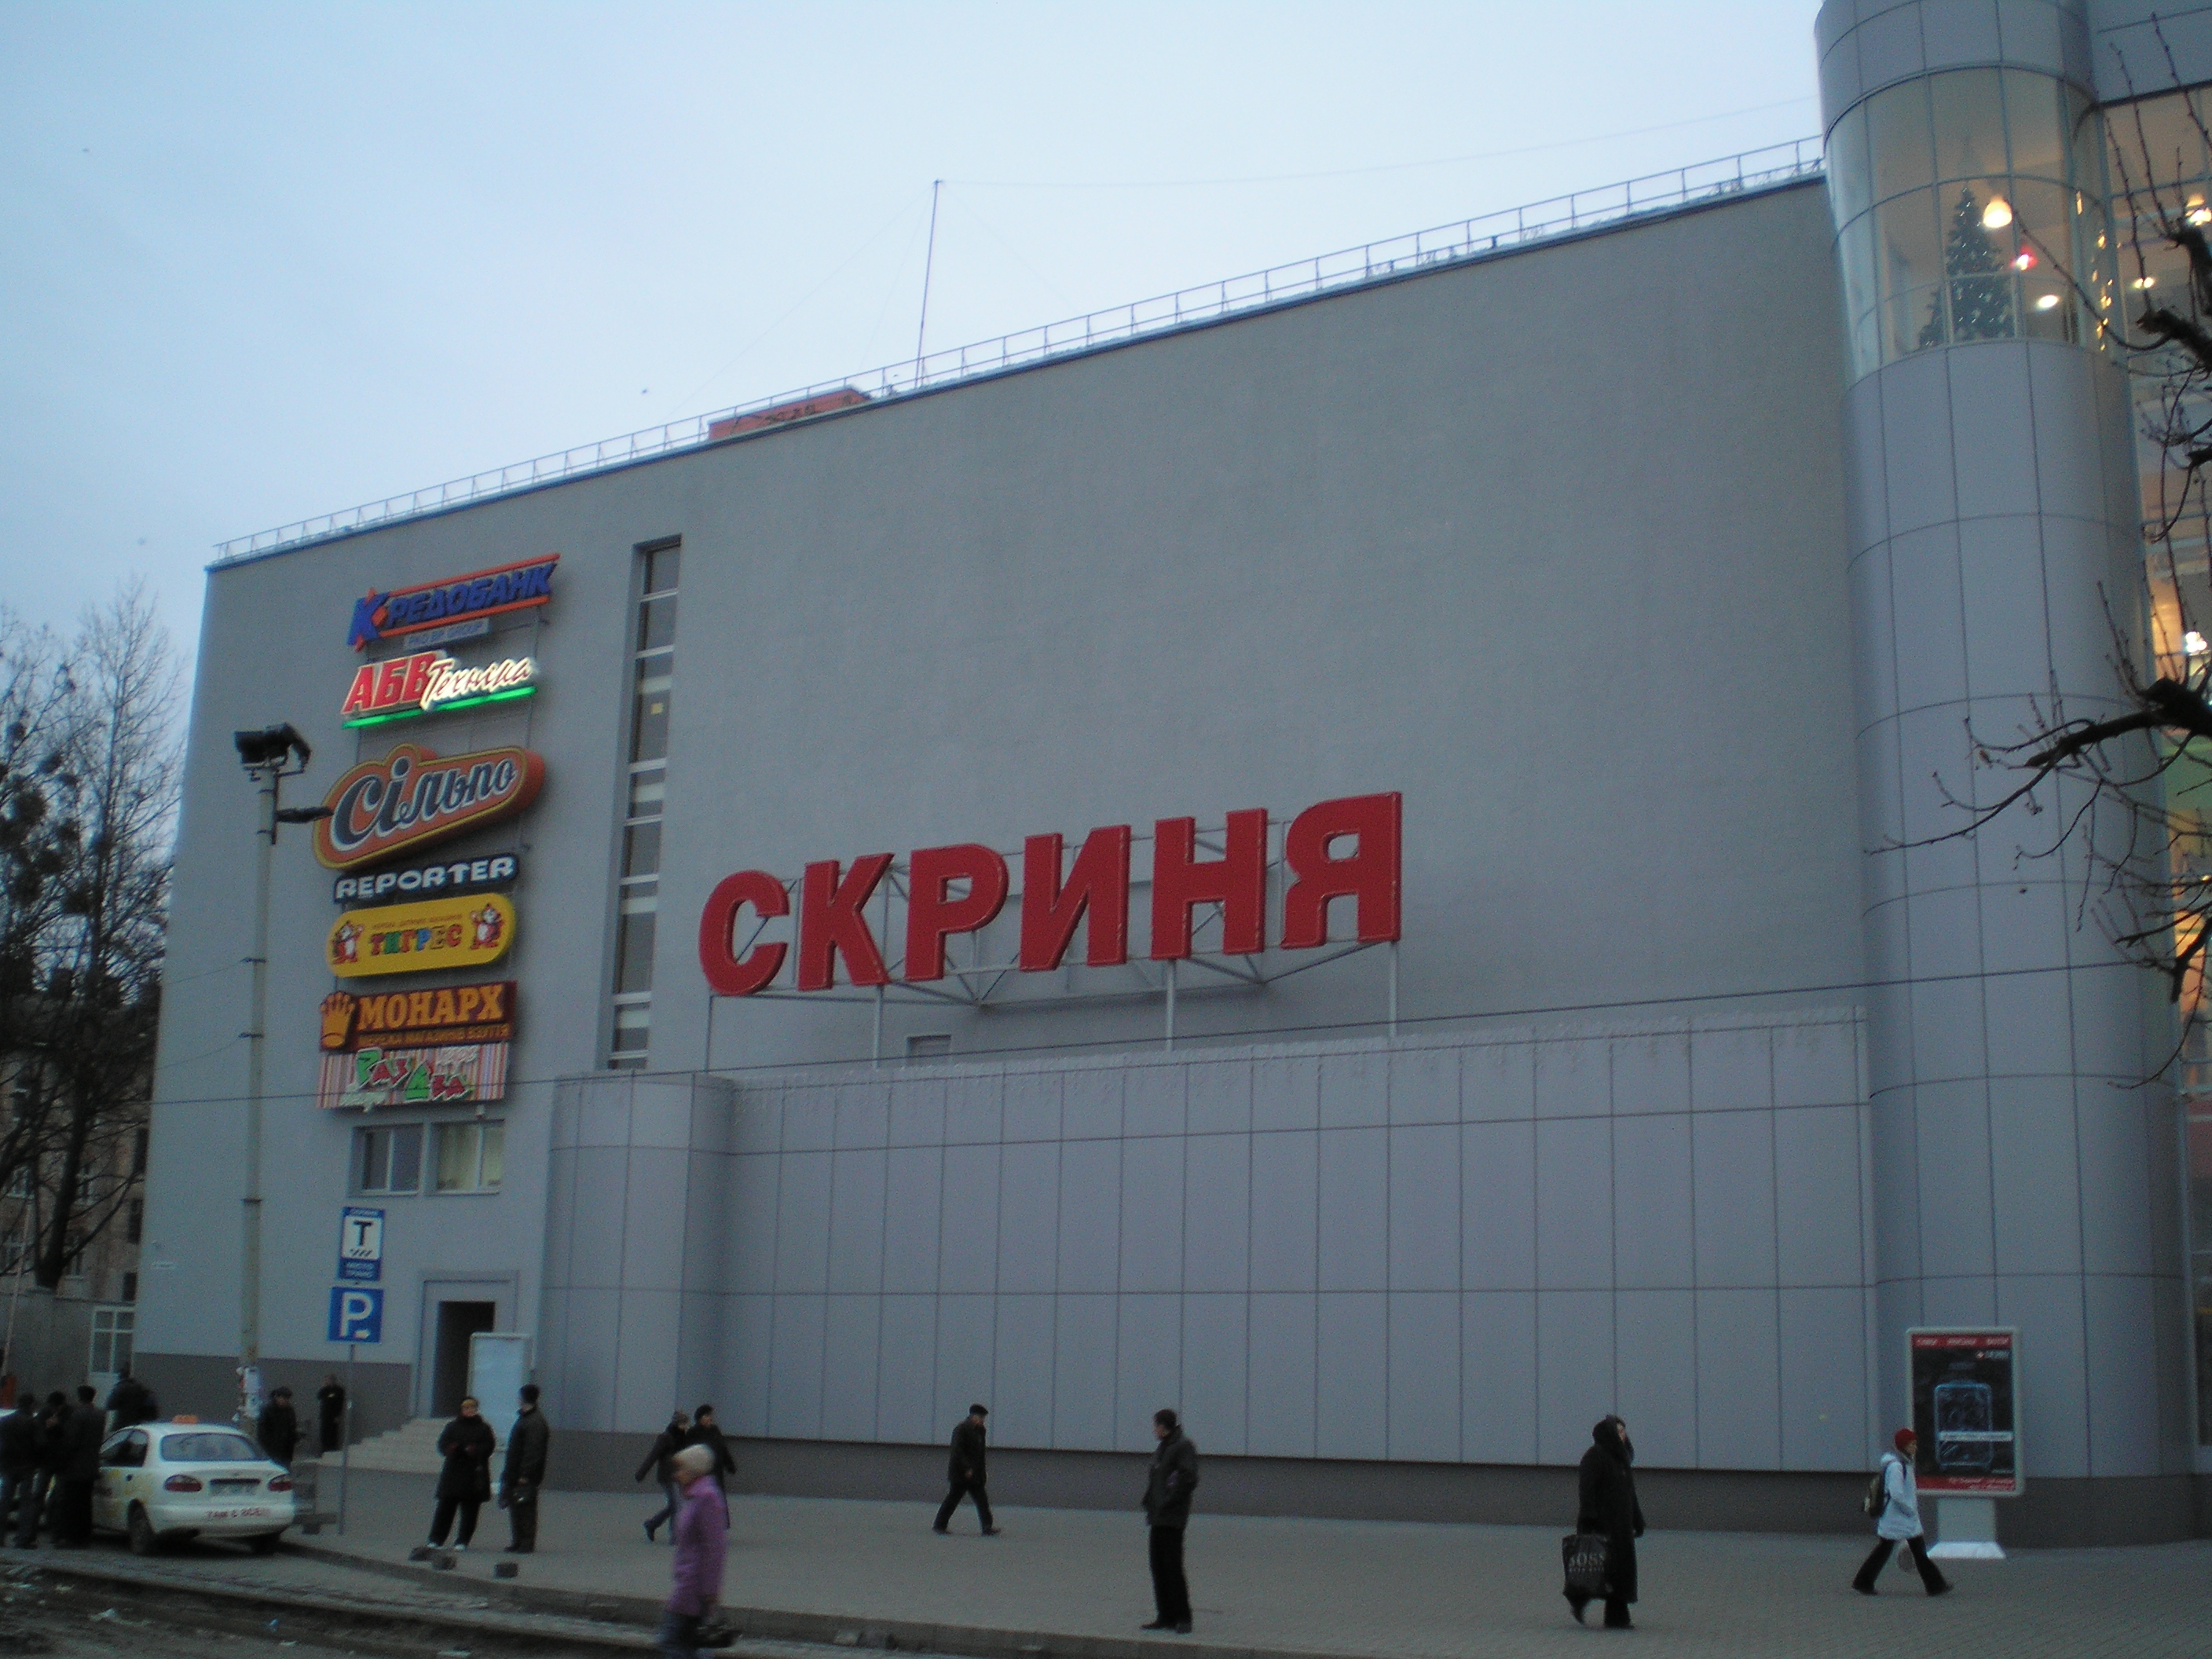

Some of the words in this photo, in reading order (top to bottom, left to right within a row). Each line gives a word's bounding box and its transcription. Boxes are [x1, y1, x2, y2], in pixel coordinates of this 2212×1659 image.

[342, 651, 441, 713] АБВ
[330, 756, 516, 851] Сільпо
[336, 856, 515, 899] REPORTER
[698, 791, 1402, 996] СКРИНЯ
[357, 984, 504, 1031] МОНАРХ
[339, 1291, 373, 1337] P
